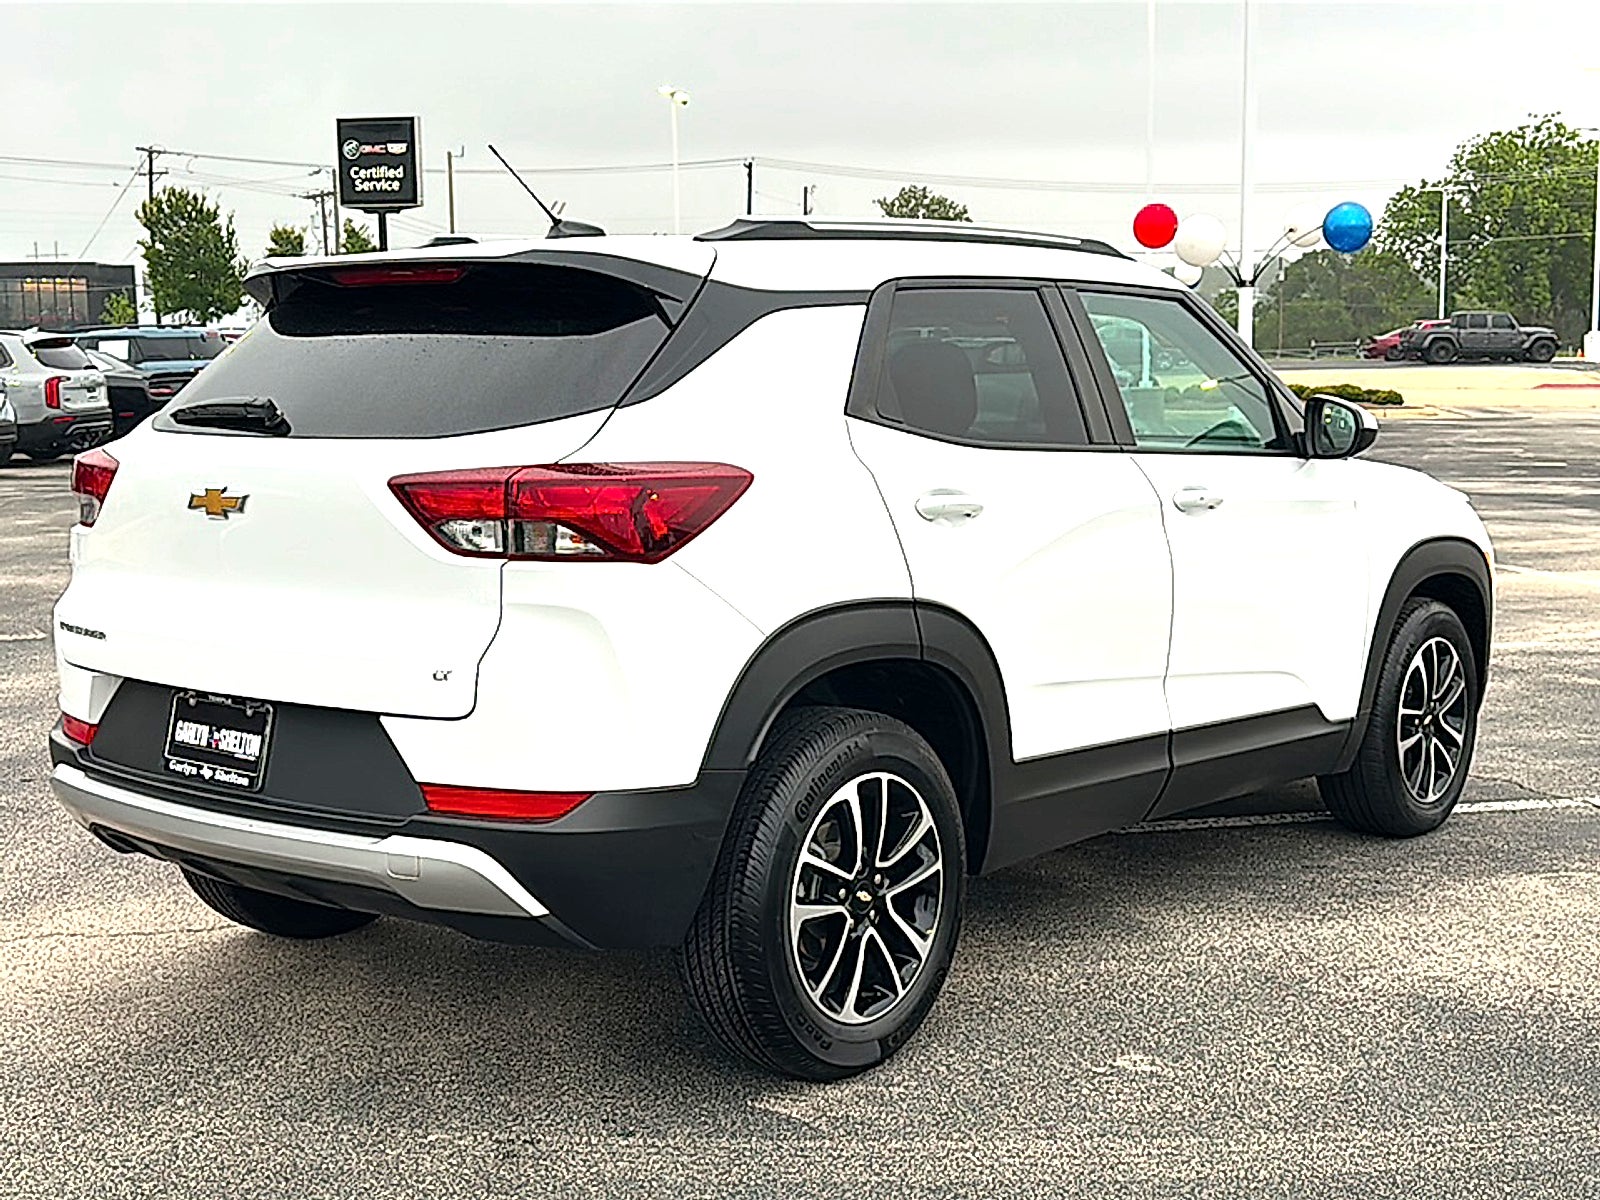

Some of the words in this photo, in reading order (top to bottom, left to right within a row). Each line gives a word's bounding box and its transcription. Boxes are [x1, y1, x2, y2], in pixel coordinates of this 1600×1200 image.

[360, 145, 387, 154] GMC
[349, 165, 404, 179] Certified
[354, 179, 400, 191] Service
[175, 719, 210, 747] GARLYN
[218, 728, 262, 757] SHELTON
[169, 759, 197, 776] Garlyn
[213, 770, 249, 786] Shelton
[795, 744, 855, 822] Continental
